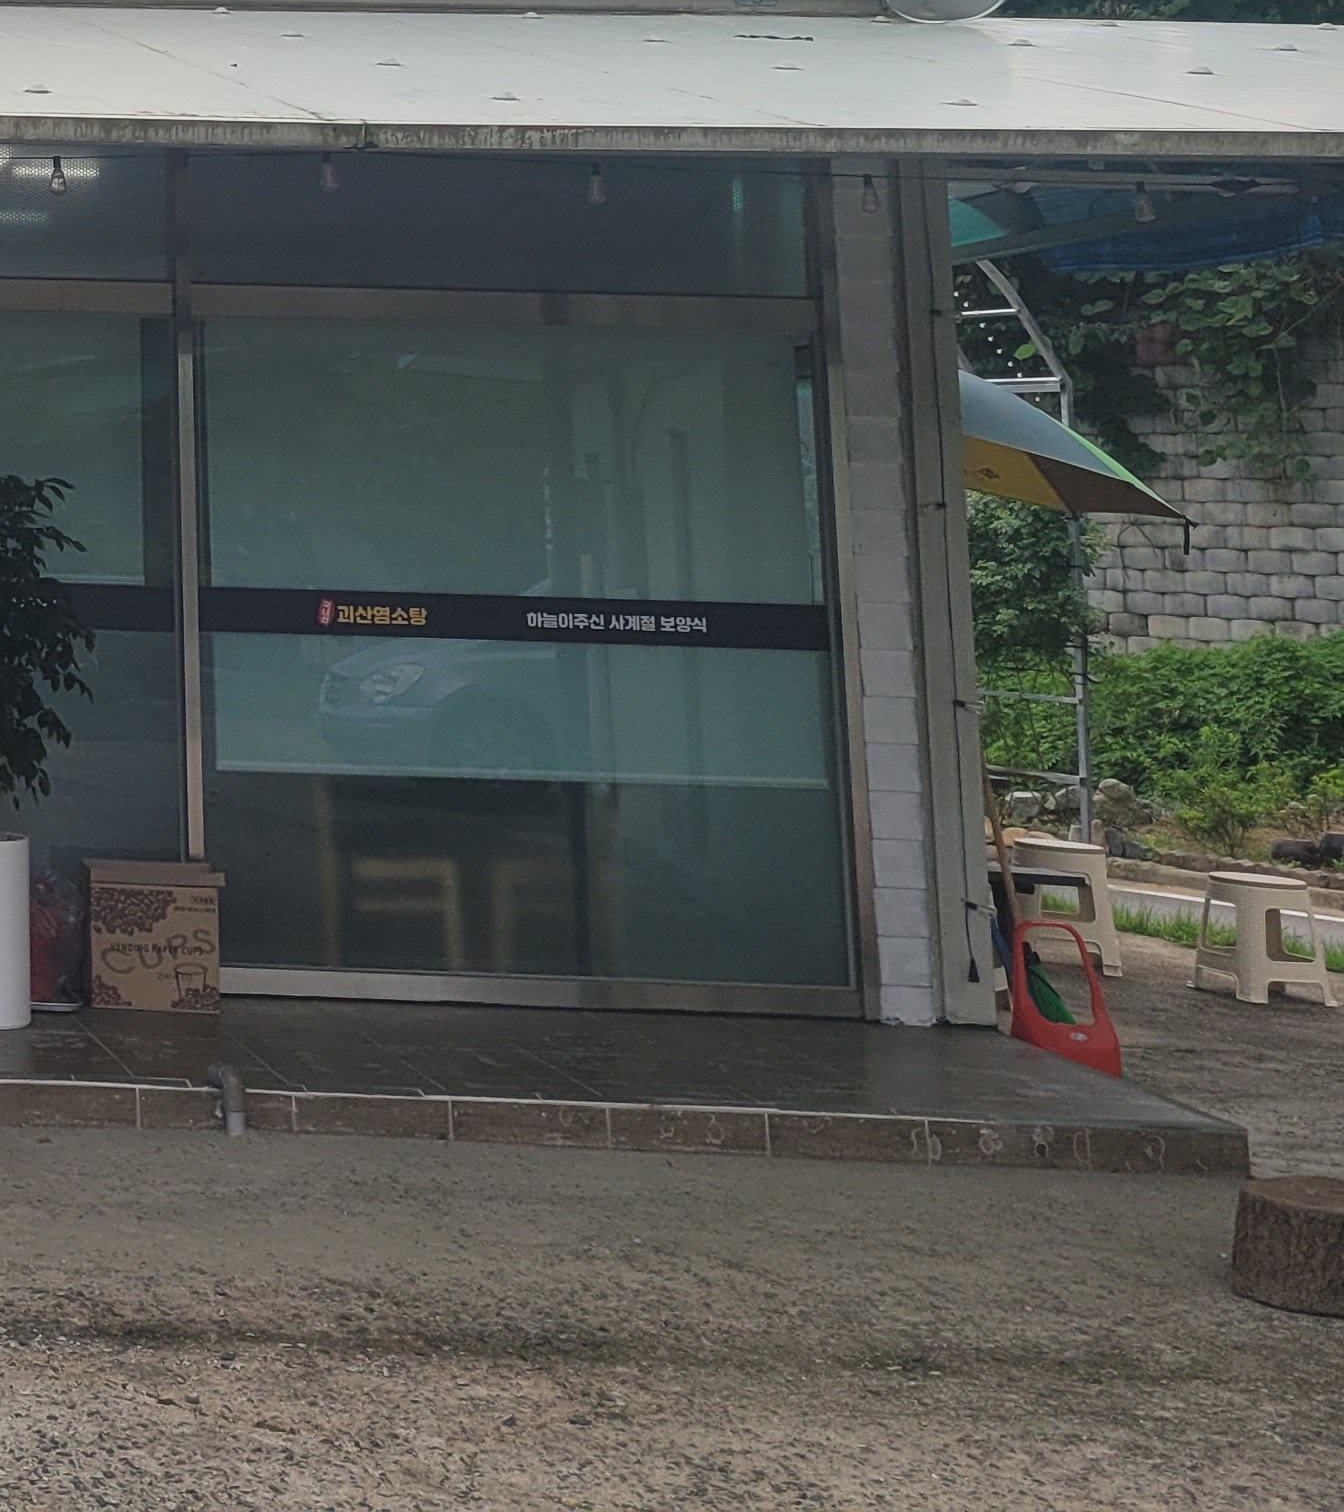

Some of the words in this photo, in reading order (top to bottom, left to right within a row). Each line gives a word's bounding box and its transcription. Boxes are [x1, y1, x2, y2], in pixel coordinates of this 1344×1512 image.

[336, 605, 428, 626] 괴산염소탕
[526, 611, 605, 630] 하늘이주신
[608, 613, 656, 632] 사계절
[659, 615, 708, 634] 보양식
